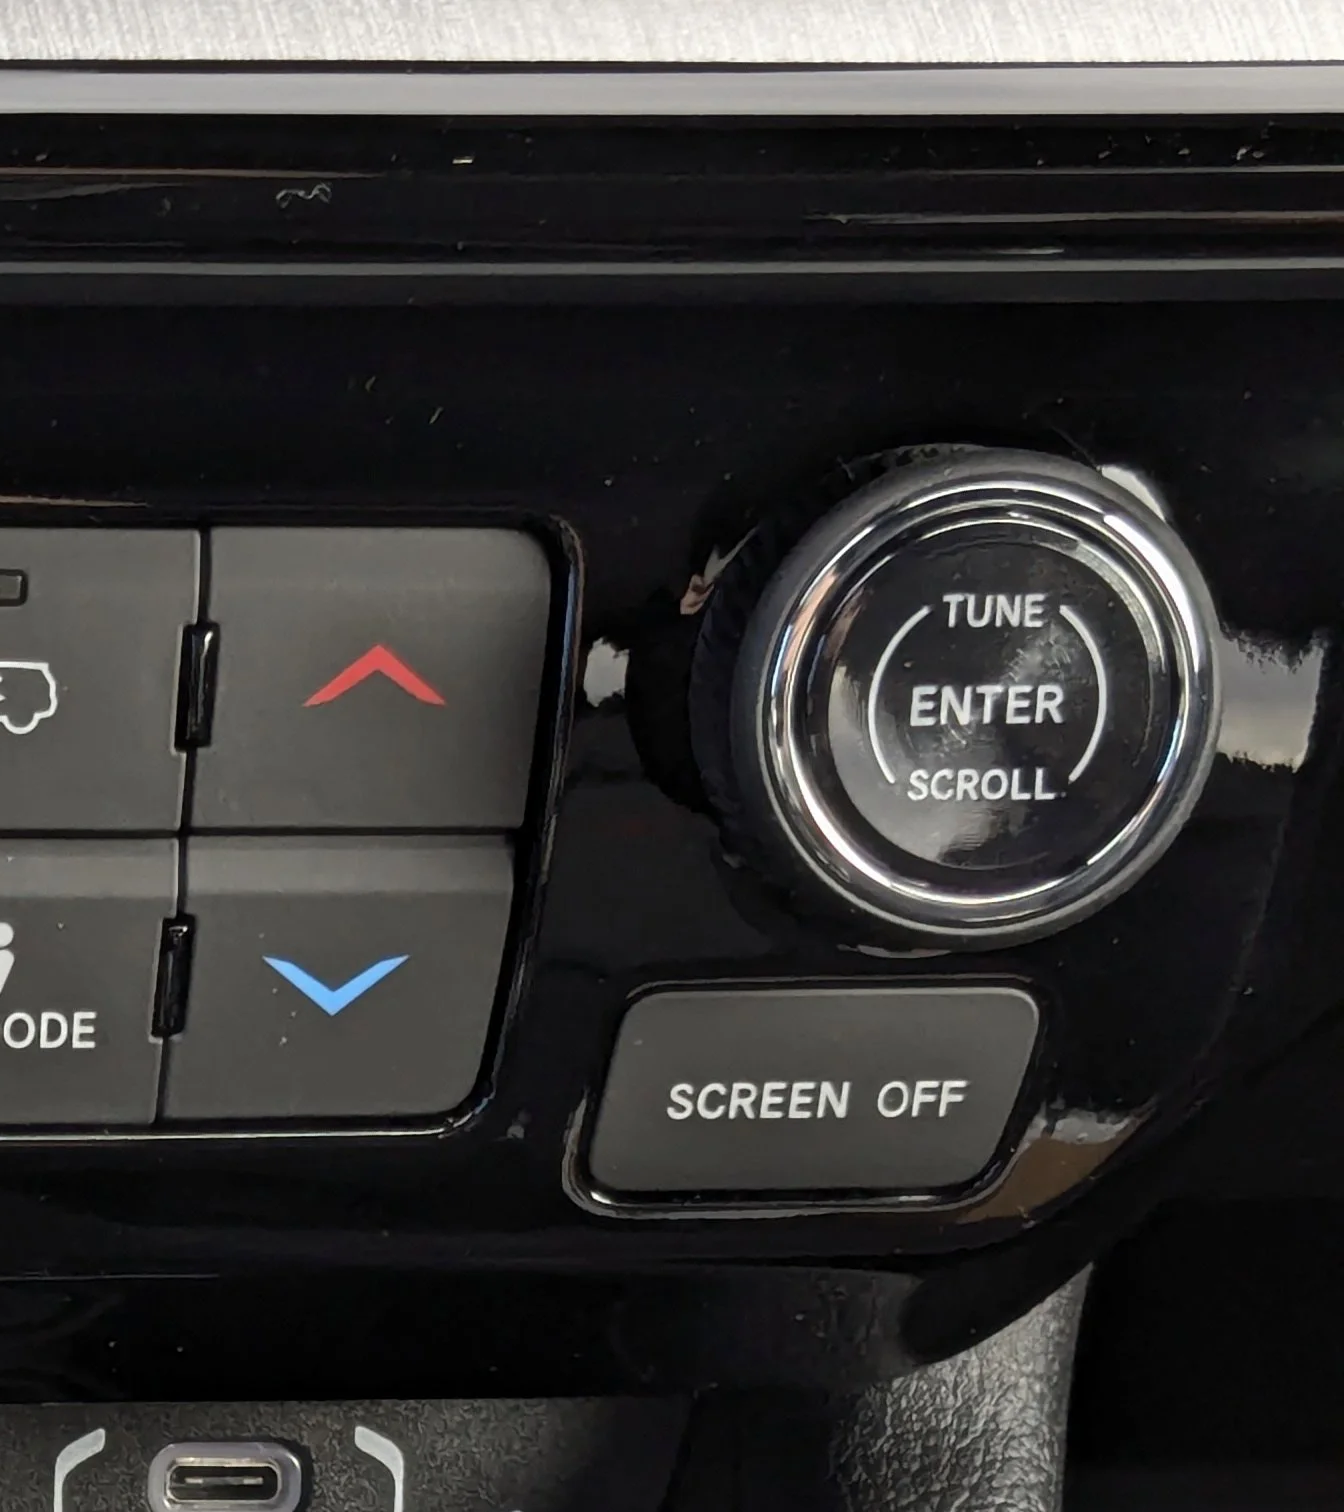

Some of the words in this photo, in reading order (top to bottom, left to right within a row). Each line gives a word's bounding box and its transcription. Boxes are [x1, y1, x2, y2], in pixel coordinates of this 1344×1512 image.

[942, 592, 1048, 629] TUNE
[909, 682, 1065, 727] ENTER
[906, 767, 1058, 802] SCROLL
[666, 1080, 852, 1121] SCREEN
[876, 1079, 969, 1118] OFF
